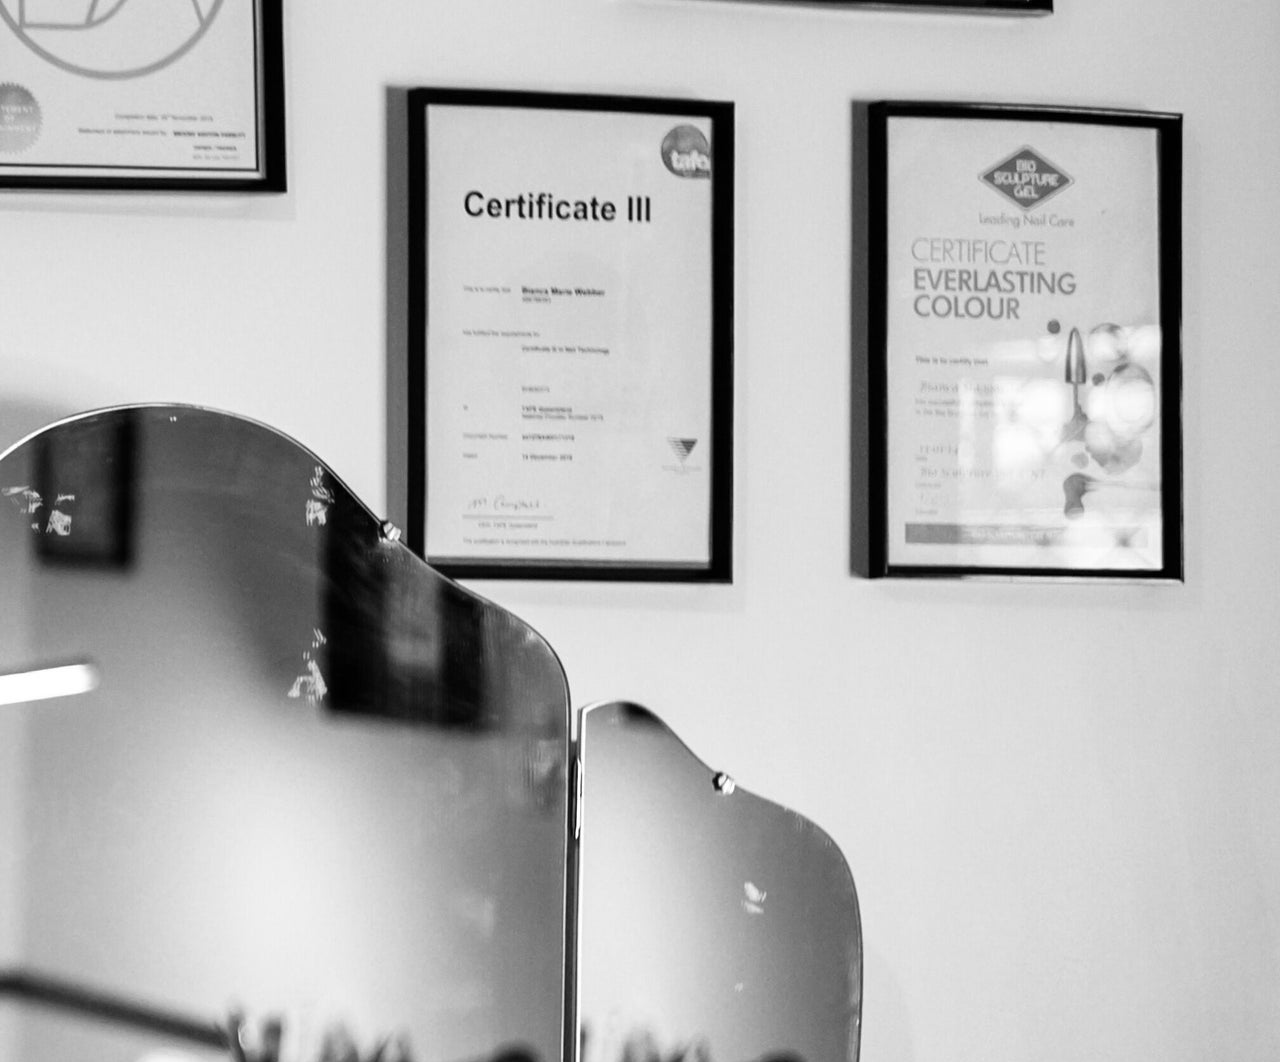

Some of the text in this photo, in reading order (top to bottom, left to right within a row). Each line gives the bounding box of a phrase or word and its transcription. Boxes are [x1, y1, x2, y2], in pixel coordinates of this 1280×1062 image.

[1015, 159, 1036, 172] BIO
[993, 171, 1059, 187] SCULPTURE
[1012, 185, 1039, 199] GEL
[463, 190, 651, 222] Certificate III
[978, 213, 1074, 229] Leading Nail Care
[911, 237, 1046, 266] CERTIFICATE
[913, 267, 1077, 295] EVERLASTING
[913, 294, 1020, 320] COLOUR
